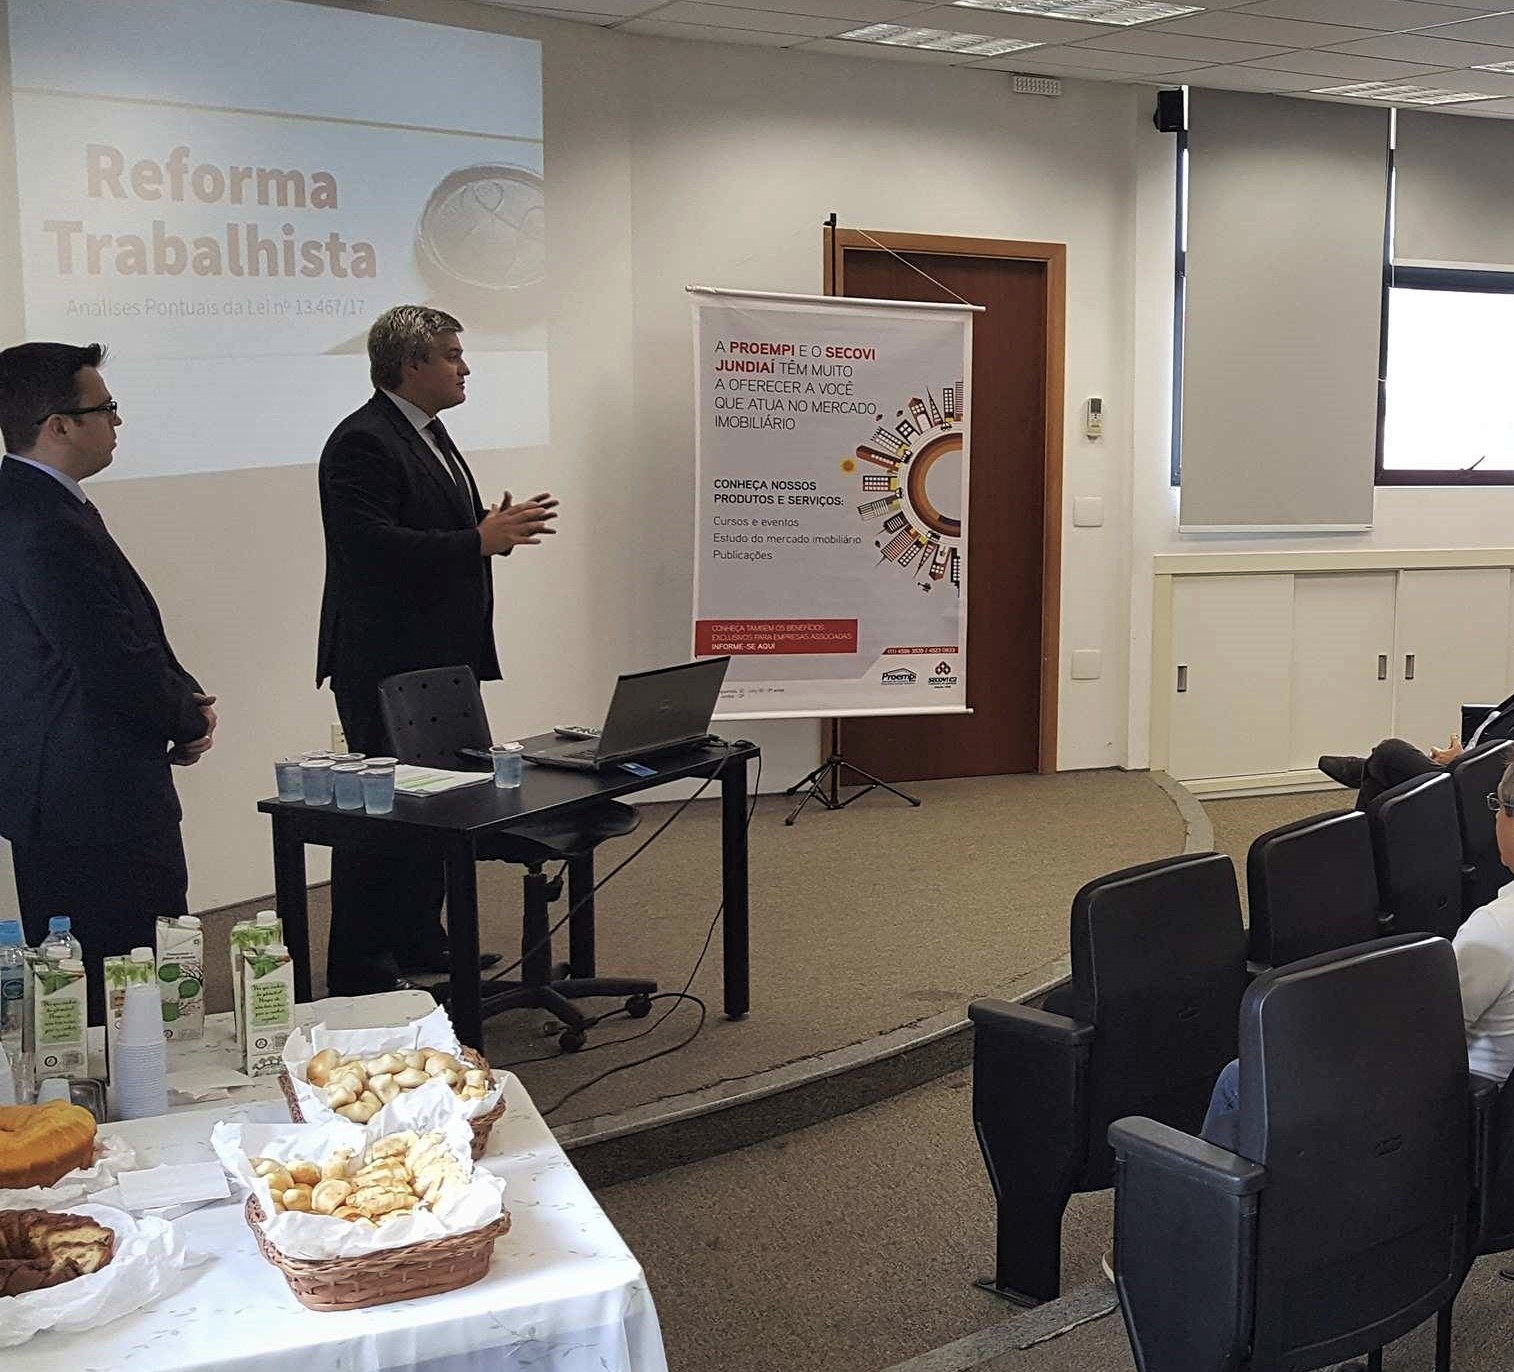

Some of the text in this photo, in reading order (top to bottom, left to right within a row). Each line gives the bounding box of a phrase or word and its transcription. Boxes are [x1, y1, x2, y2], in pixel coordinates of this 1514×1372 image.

[85, 143, 339, 210] Reforma
[43, 219, 377, 280] Trabalhista
[145, 298, 218, 317] Pontuais
[223, 298, 243, 316] da
[247, 298, 269, 316] Lei
[294, 298, 365, 317] 13.467/17
[714, 341, 876, 361] A PROEMPI E O SECOVI
[714, 358, 853, 378] JUNDIAÍ TÊM MUITO
[714, 378, 854, 396] A OFERECER A VOCÊ
[714, 397, 877, 415] QUE ATUA NO MERCADO
[715, 414, 796, 431] IMOBILIÁRIO
[713, 479, 817, 492] CONHEÇA NOSSOS
[713, 494, 844, 508] PRODUTOS E SERVIÇOS:
[713, 516, 799, 527] Cursos e eventos
[713, 533, 861, 545] Estudo do mercado imobiliário
[713, 550, 773, 562] Publicações
[810, 632, 852, 640] ASSOCIADAS
